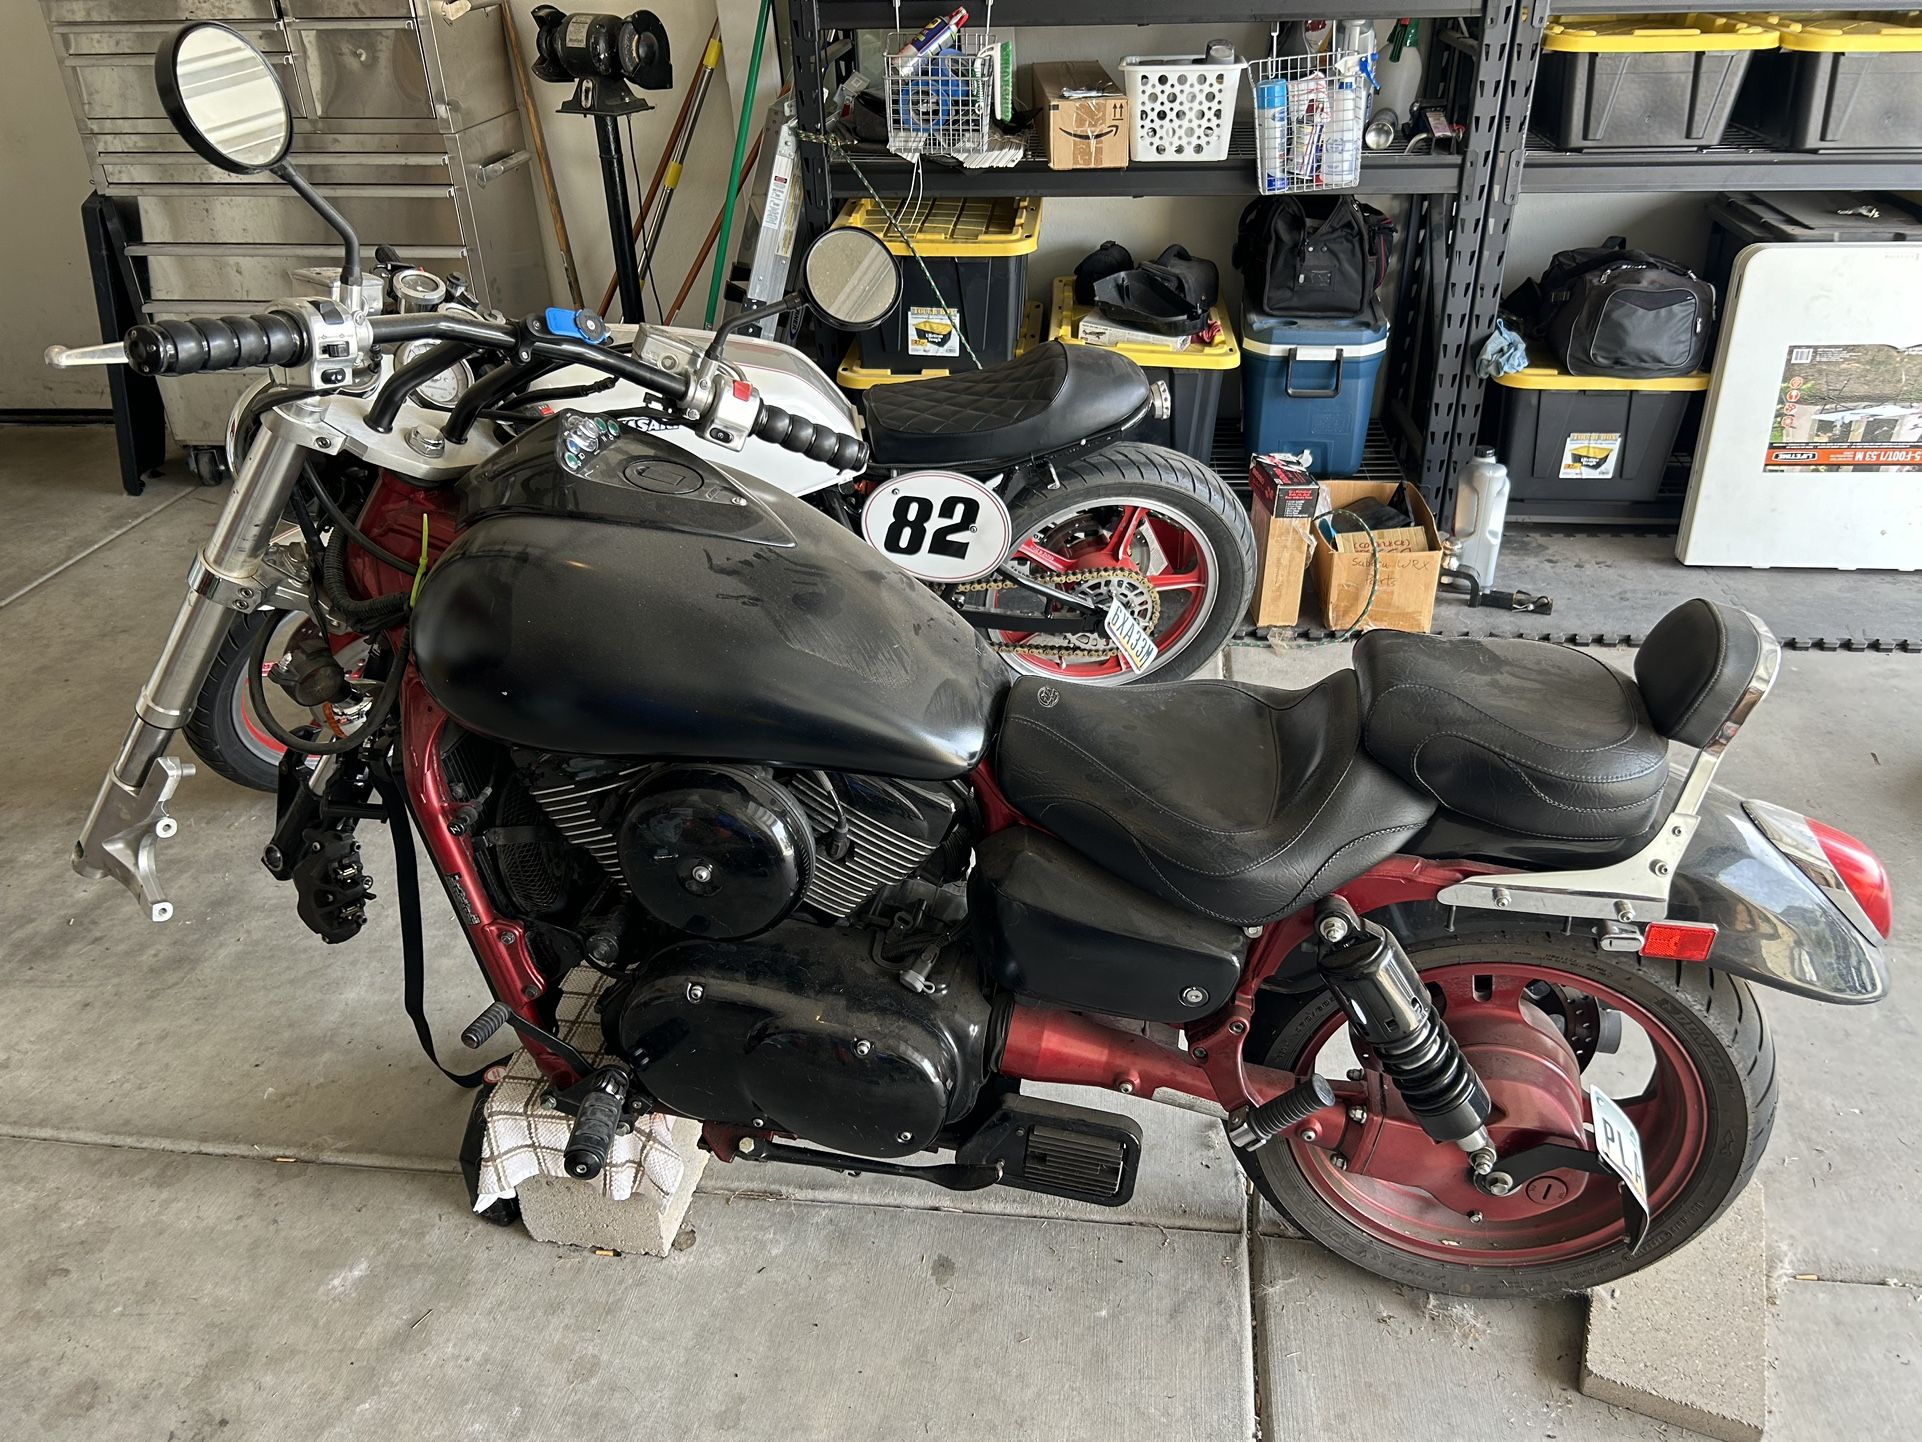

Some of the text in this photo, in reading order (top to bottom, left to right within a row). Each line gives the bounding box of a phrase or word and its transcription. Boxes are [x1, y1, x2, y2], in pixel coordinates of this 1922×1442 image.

[884, 495, 980, 560] 82
[1396, 558, 1430, 571] WRX
[1111, 606, 1154, 668] 6XA33M
